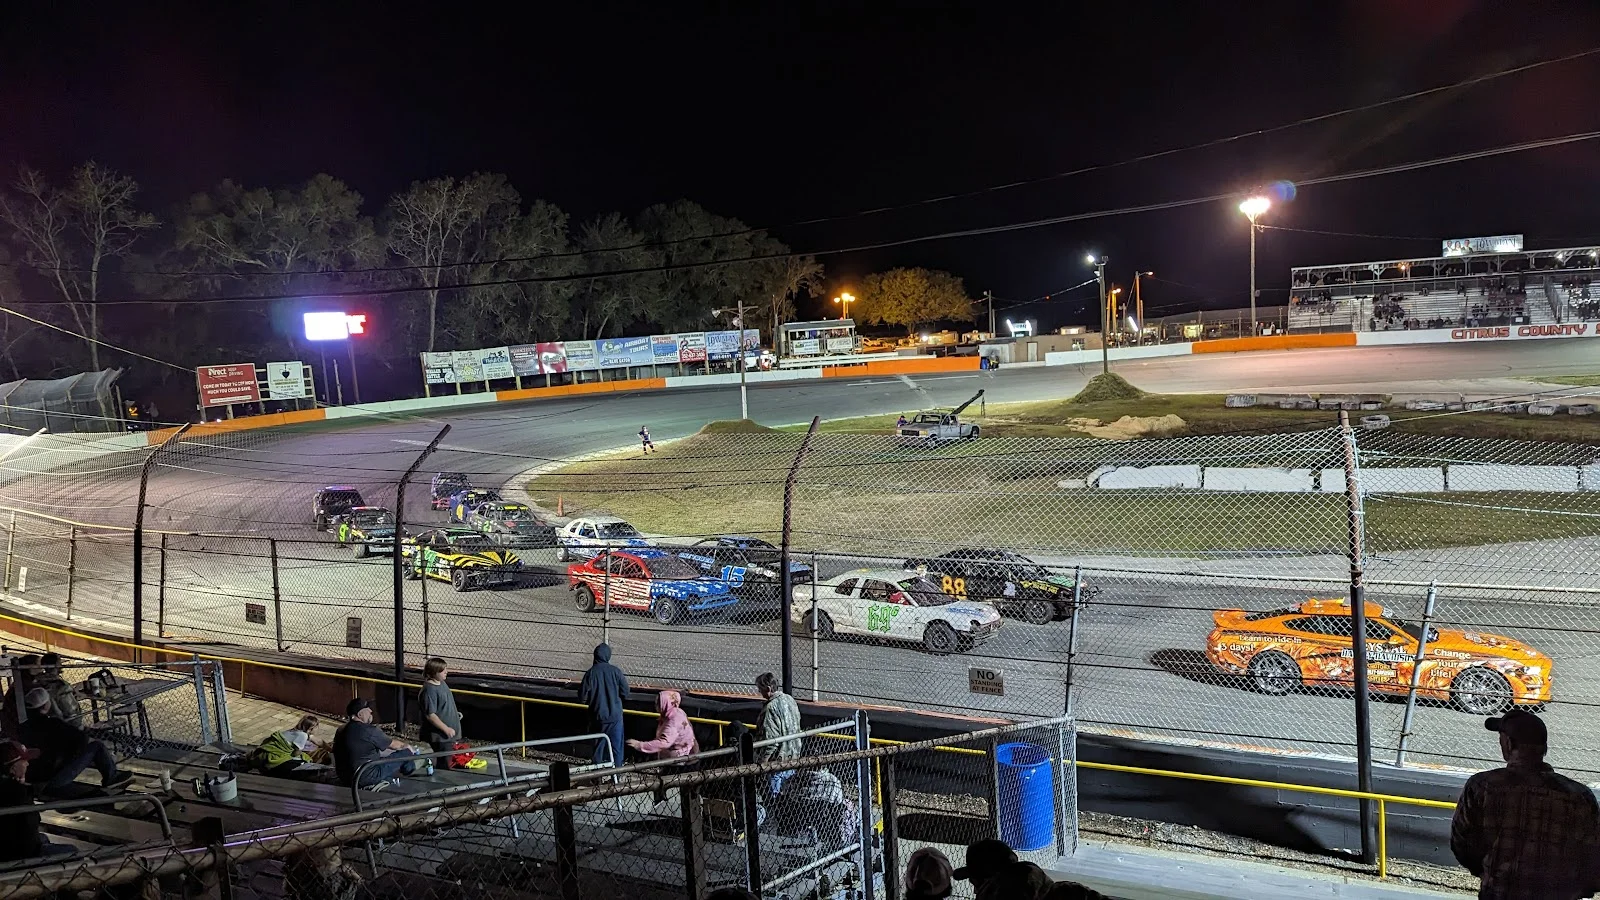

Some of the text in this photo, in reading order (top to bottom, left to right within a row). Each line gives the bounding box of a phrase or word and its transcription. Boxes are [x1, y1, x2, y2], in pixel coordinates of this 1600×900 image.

[1452, 327, 1510, 339] CITRUS
[1518, 324, 1587, 336] COUNTY
[624, 338, 649, 347] AIRBOAT
[630, 345, 649, 353] TOURS
[721, 564, 747, 587] 15
[942, 575, 968, 600] 88
[1239, 634, 1261, 642] Learn
[1275, 635, 1292, 643] ride
[1220, 643, 1255, 653] 3 days!
[1434, 648, 1471, 660] Change
[1437, 659, 1459, 667] Your
[977, 670, 995, 680] NO
[1430, 669, 1452, 678] Life!
[970, 679, 1002, 687] STANDING
